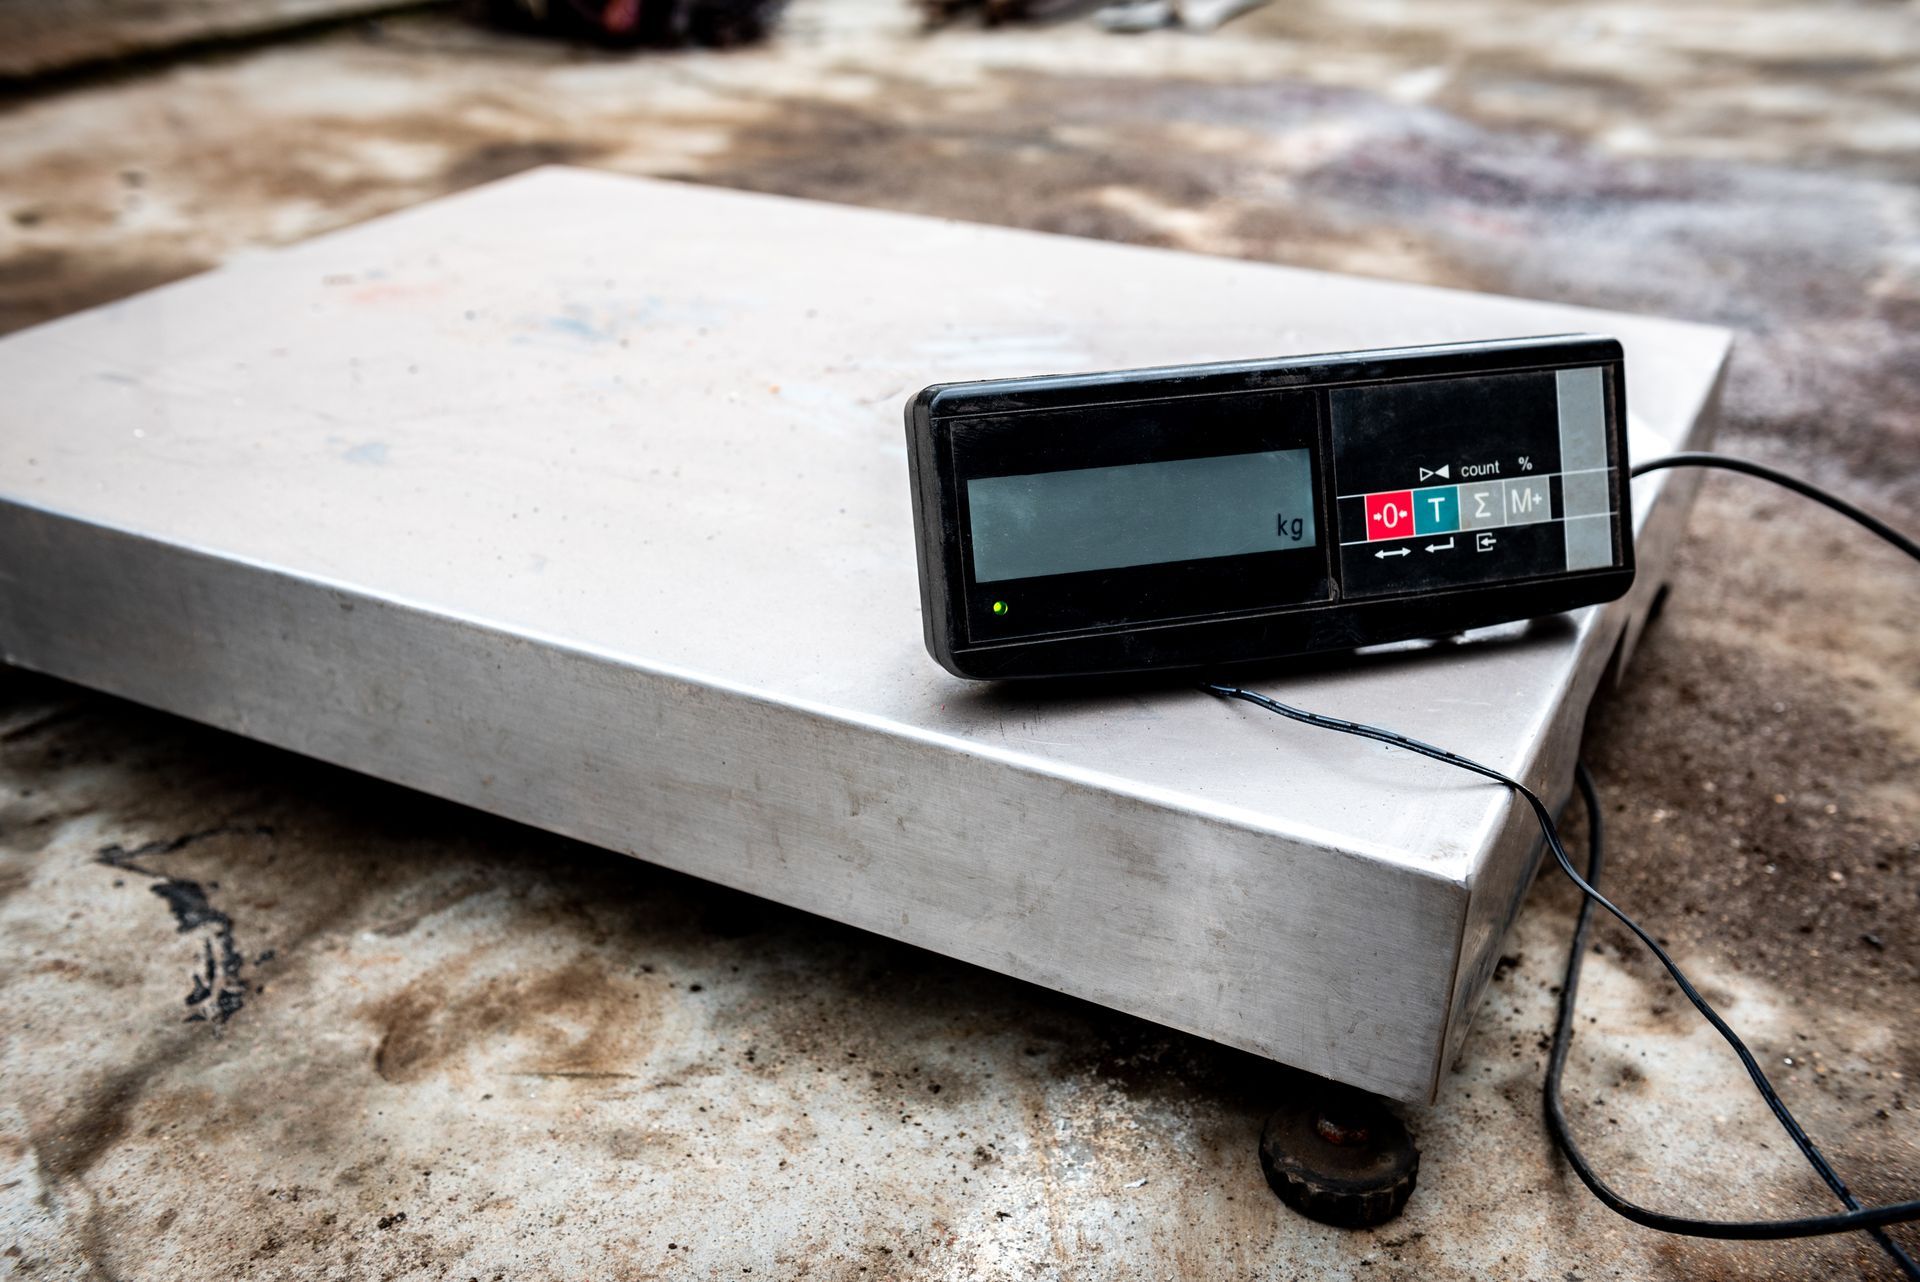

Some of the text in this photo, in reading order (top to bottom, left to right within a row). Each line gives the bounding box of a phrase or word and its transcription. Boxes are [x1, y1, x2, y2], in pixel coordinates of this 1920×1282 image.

[1461, 456, 1533, 477] count %
[1428, 497, 1445, 522] T
[1473, 492, 1492, 518] Σ
[1511, 488, 1542, 514] M+
[1277, 513, 1303, 541] kg
